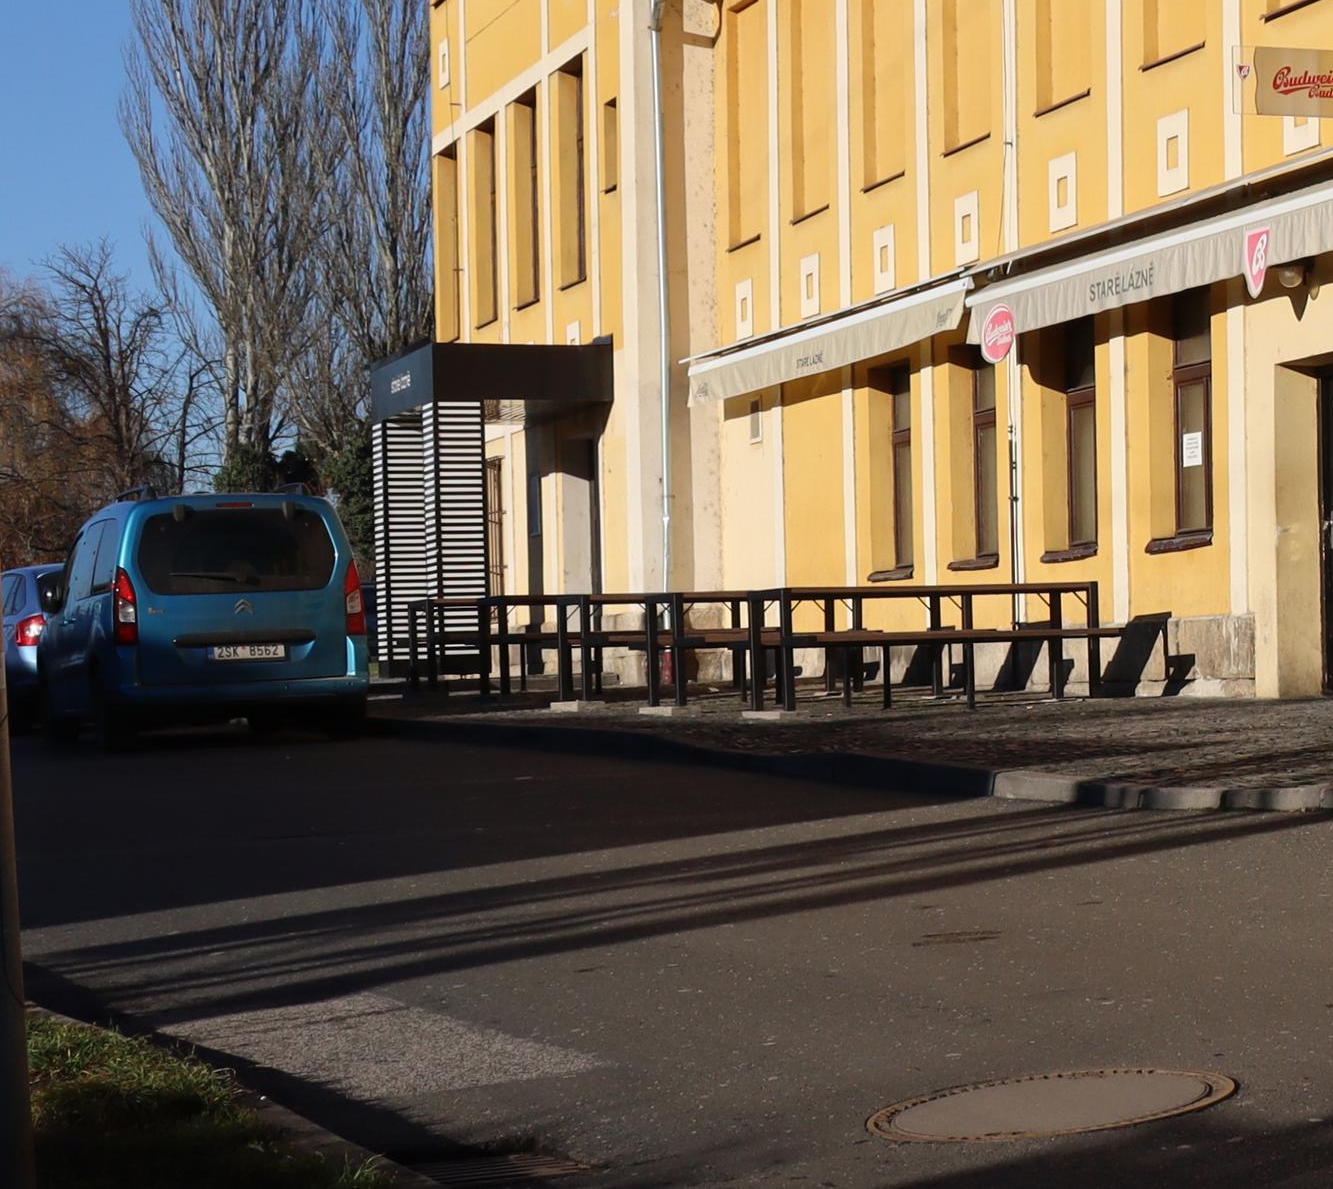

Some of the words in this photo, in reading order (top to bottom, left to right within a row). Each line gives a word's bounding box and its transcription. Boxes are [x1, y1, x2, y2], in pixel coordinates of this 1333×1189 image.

[1089, 272, 1121, 303] STARÉ
[217, 645, 240, 659] 2SK
[249, 644, 279, 657] 8562
